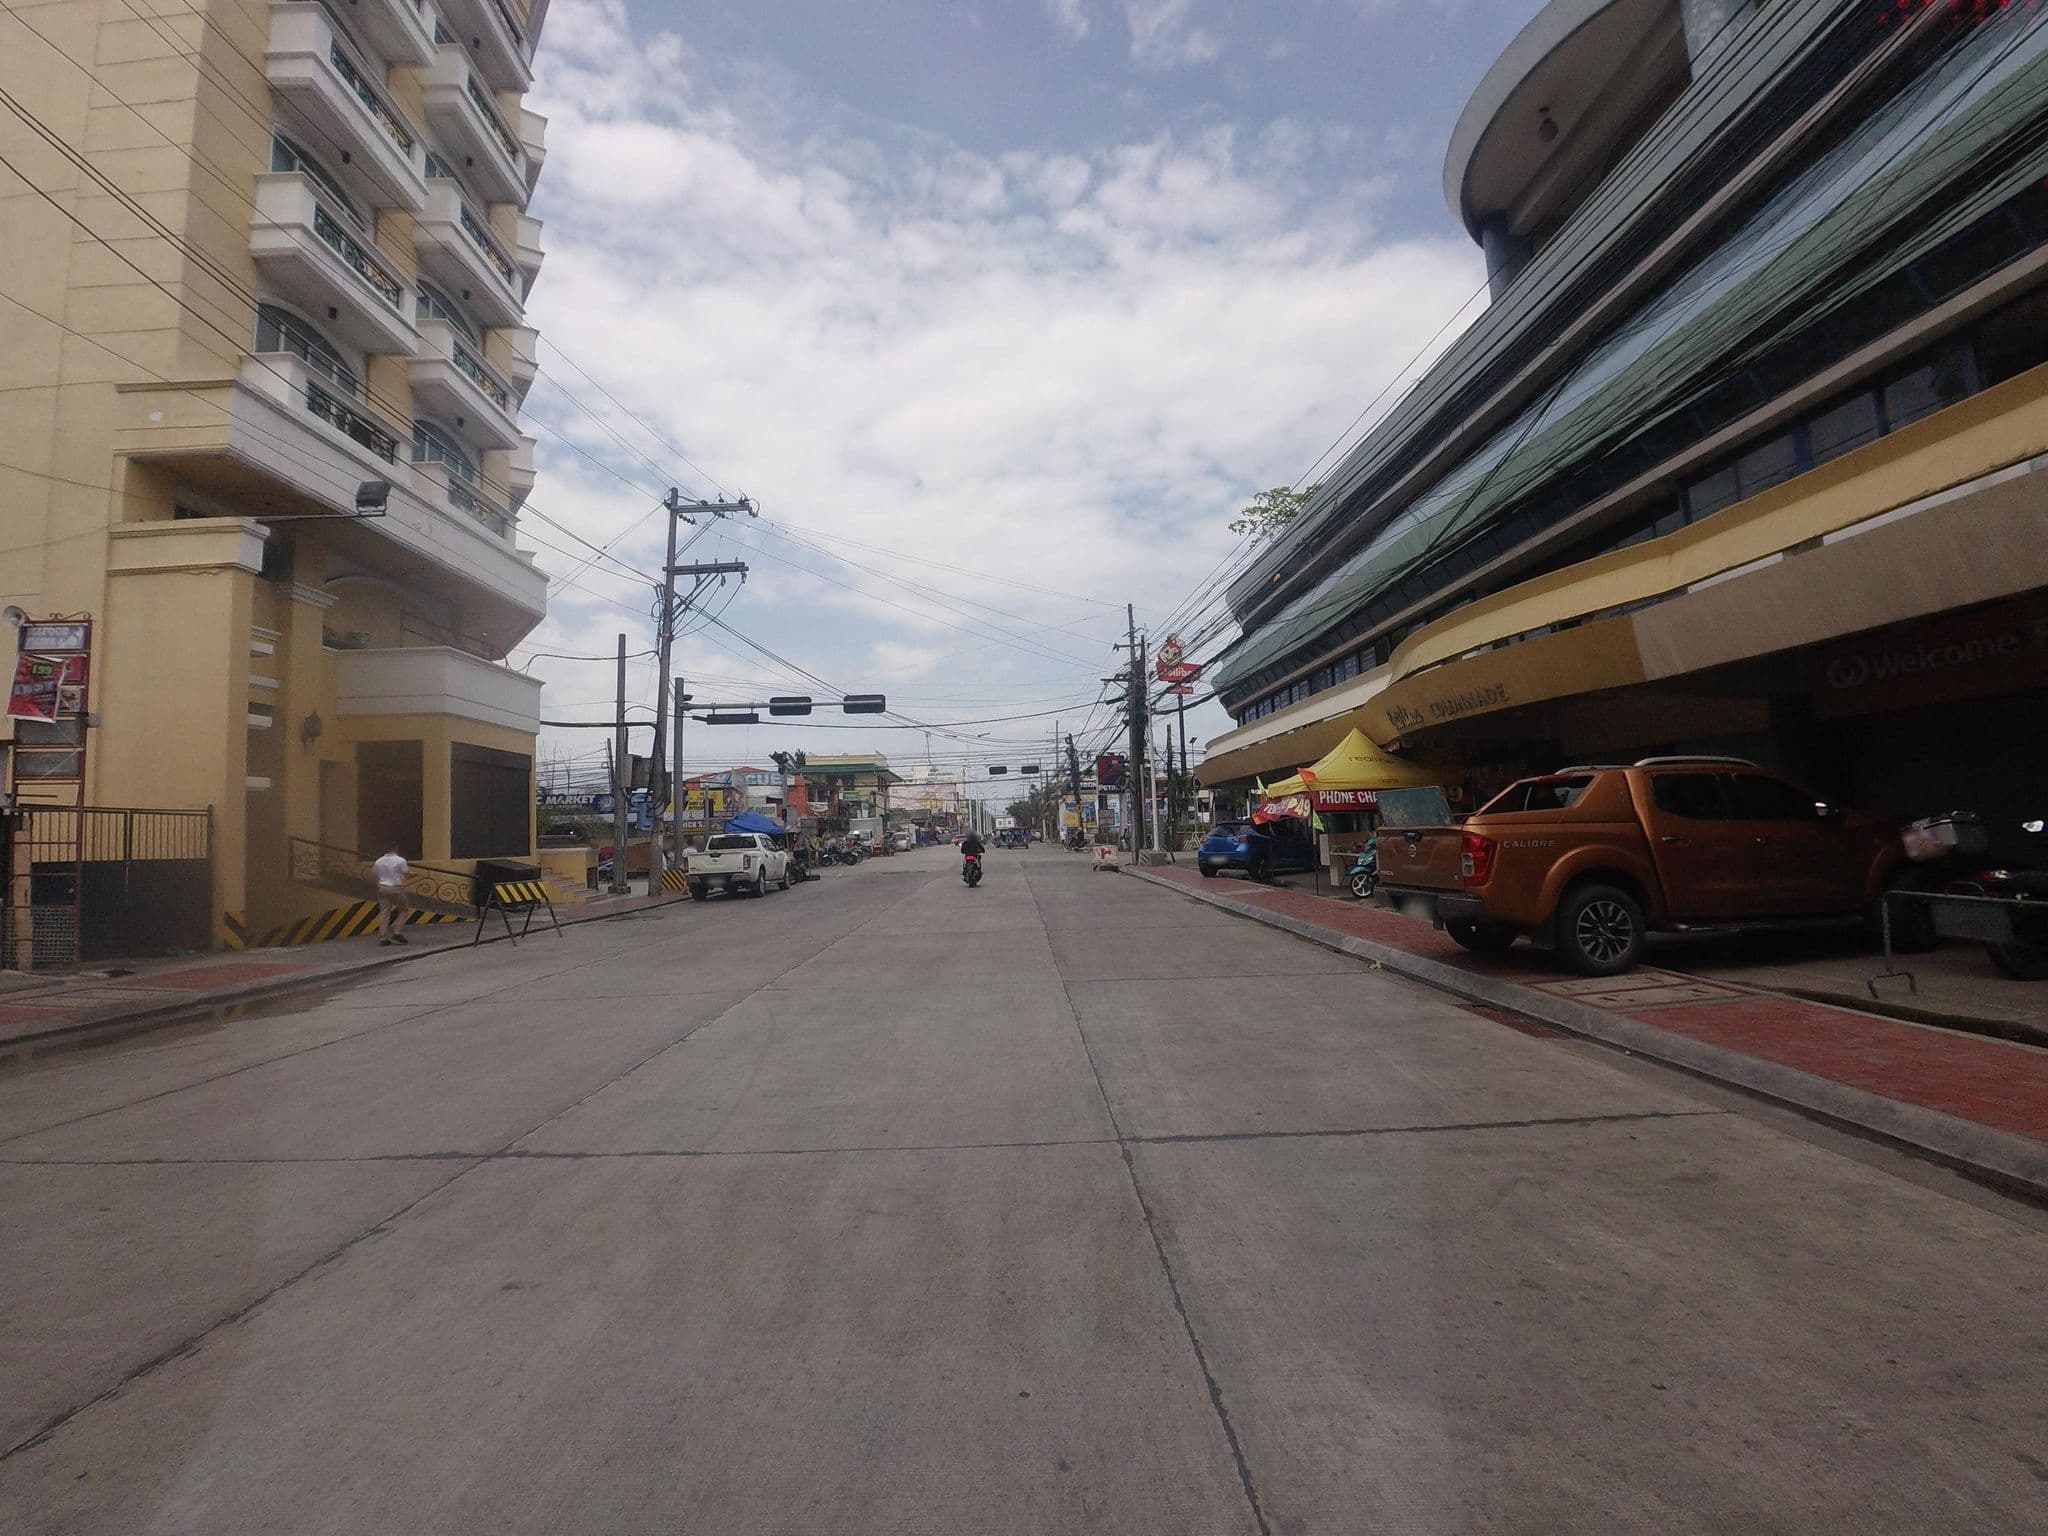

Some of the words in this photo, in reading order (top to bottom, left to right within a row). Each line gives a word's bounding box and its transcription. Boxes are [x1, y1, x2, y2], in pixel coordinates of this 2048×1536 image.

[546, 794, 595, 805] MARKET
[1319, 790, 1355, 805] PHONE
[1502, 839, 1557, 849] CALIBRE
